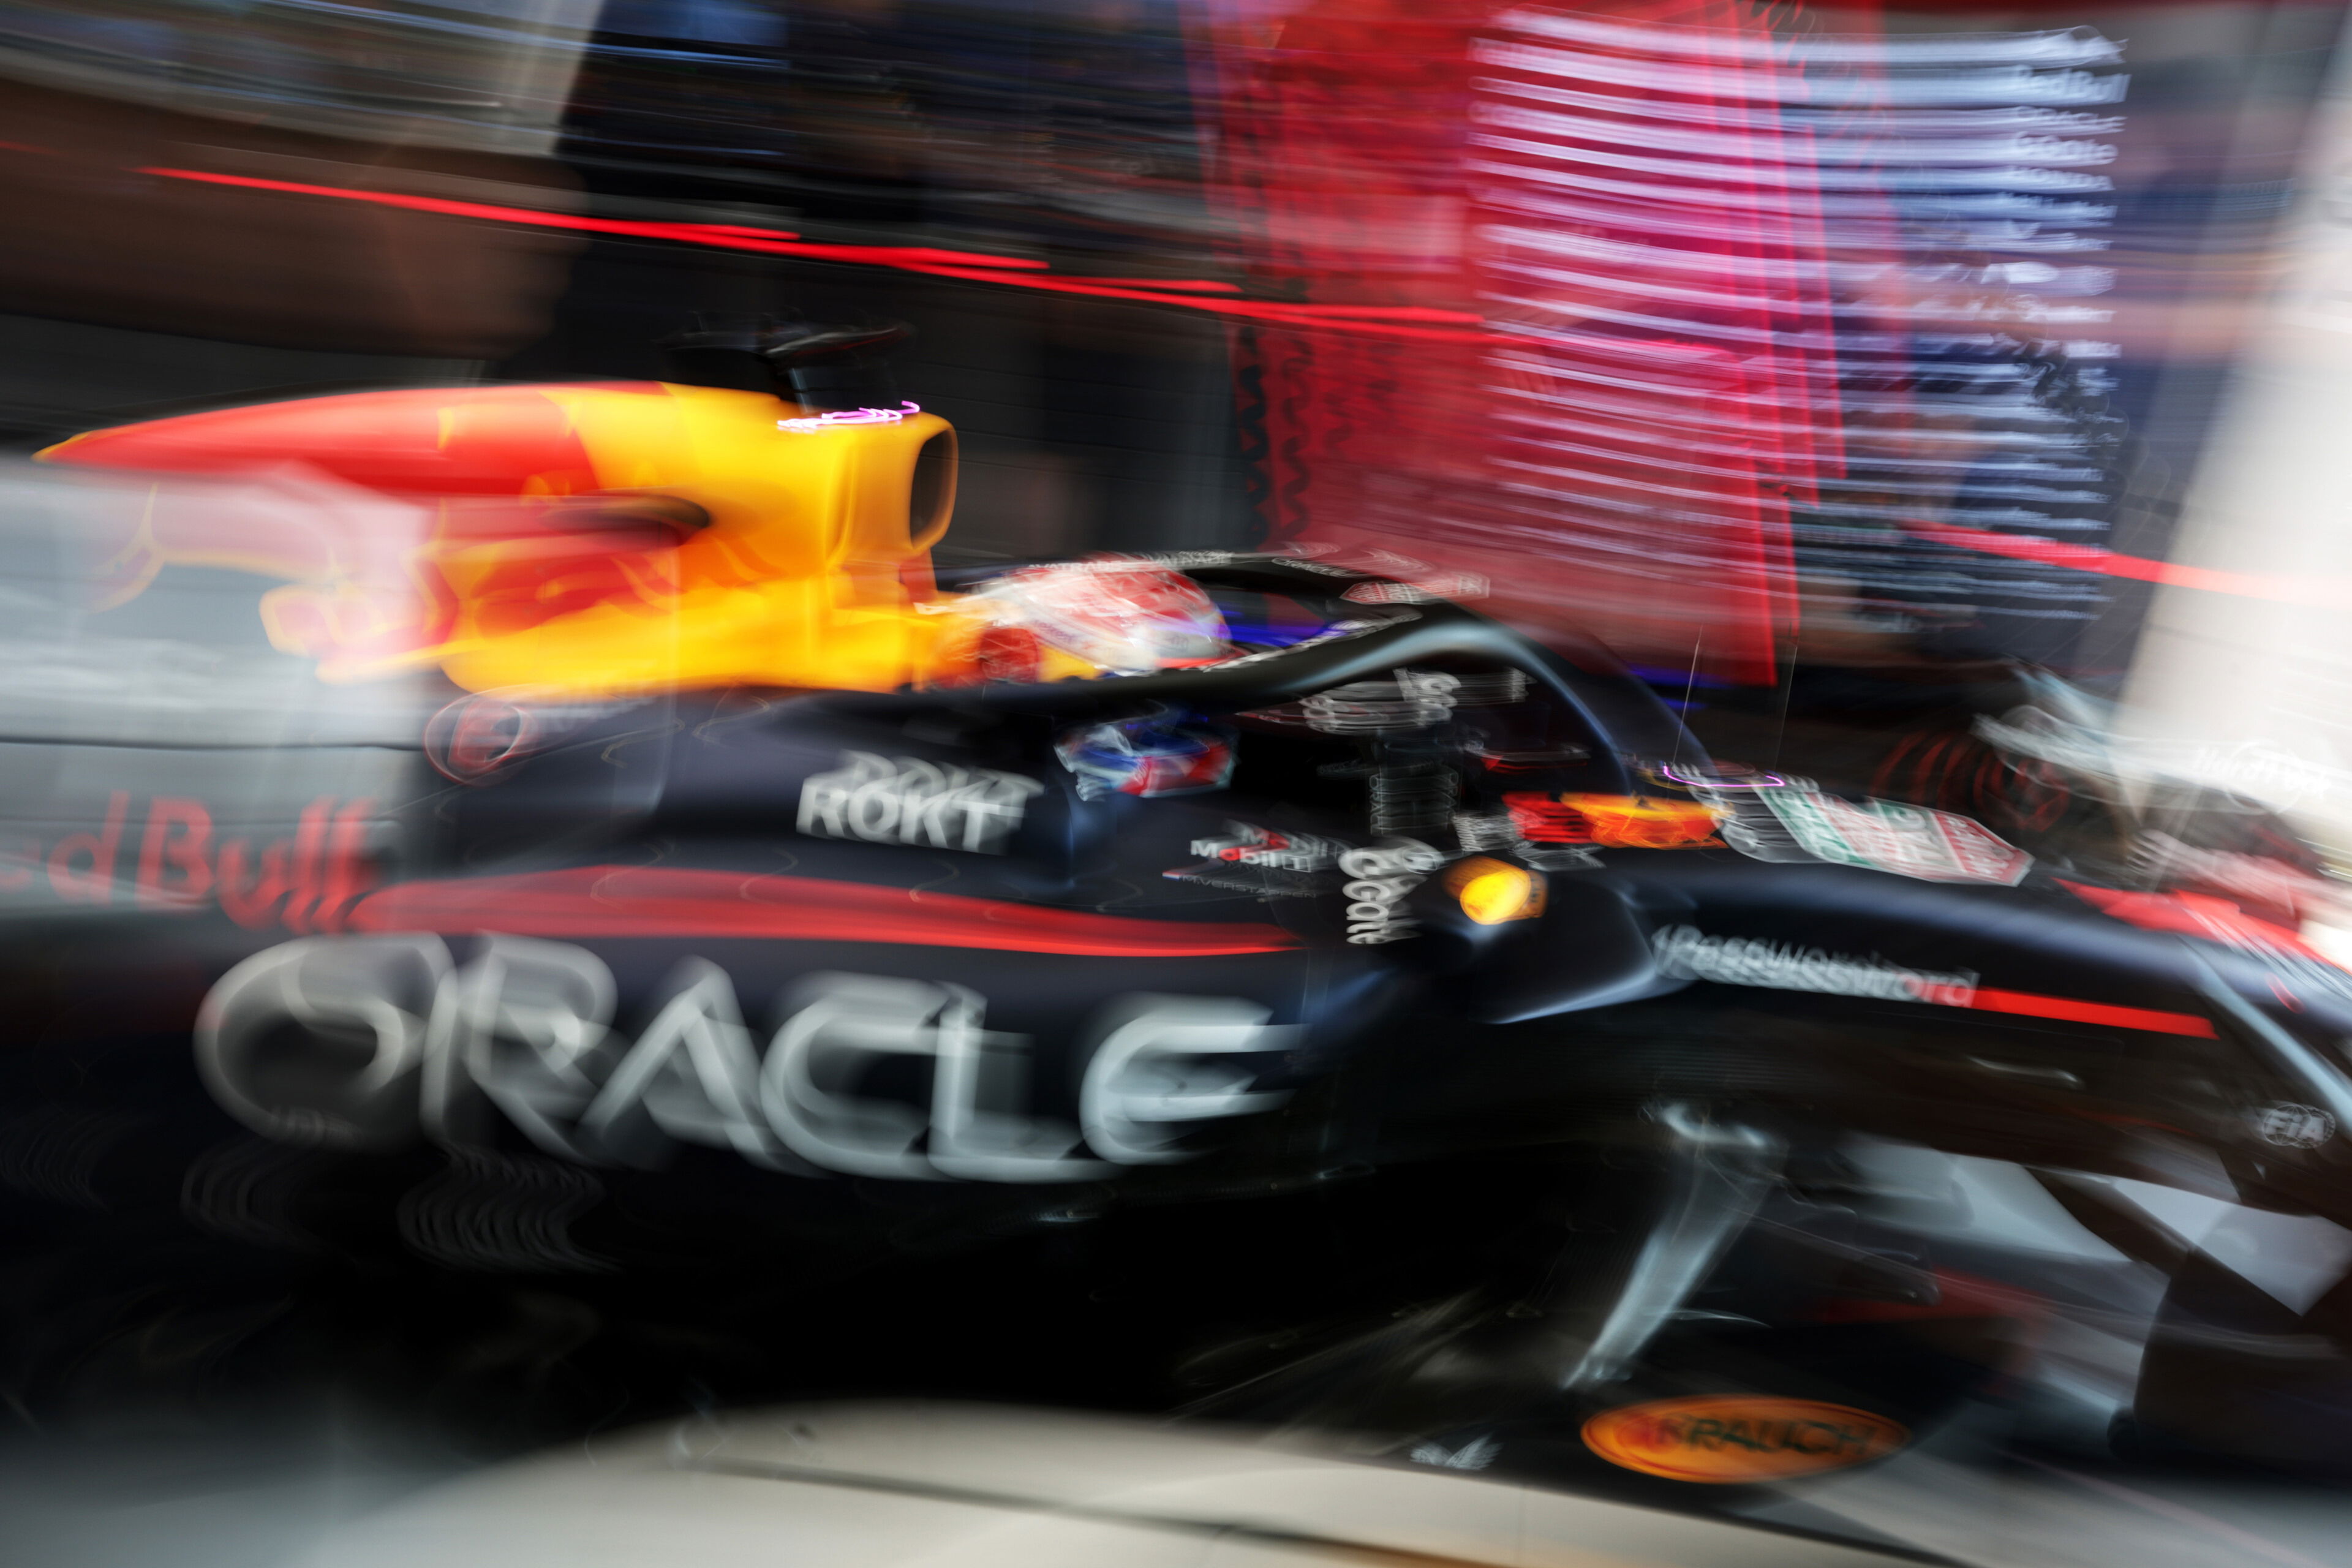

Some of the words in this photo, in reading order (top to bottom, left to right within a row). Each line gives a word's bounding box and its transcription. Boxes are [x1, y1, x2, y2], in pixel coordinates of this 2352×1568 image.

[133, 795, 379, 936] Bull
[796, 756, 1035, 853] ROKT
[192, 929, 1305, 1183] ORACLE
